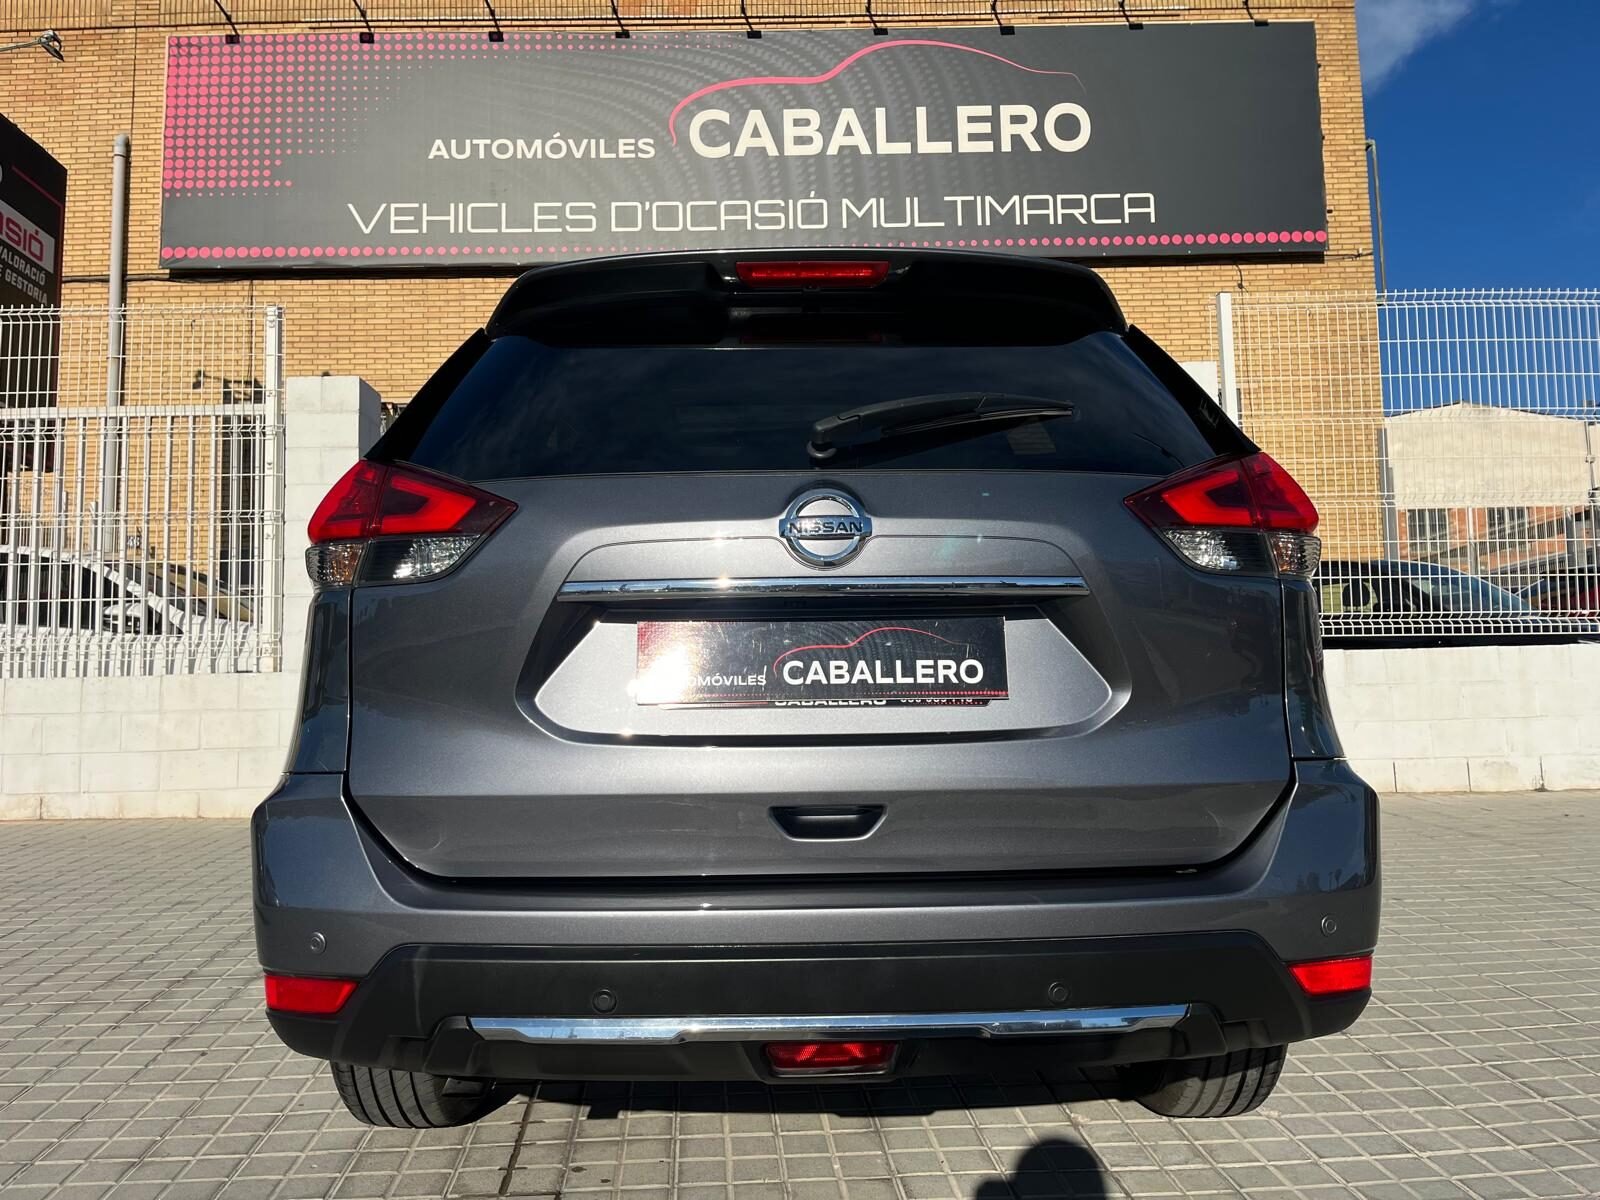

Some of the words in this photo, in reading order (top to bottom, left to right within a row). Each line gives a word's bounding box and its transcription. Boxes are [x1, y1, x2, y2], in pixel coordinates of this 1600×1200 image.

[427, 132, 656, 161] AUTOMÓVILES
[688, 102, 1092, 159] CABALLERO
[346, 201, 598, 235] VEHICLES
[610, 190, 828, 232] D'OCASIÓ
[841, 192, 1157, 229] MULTIMARCA
[0, 211, 45, 263] SIÓ
[4, 268, 48, 306] GESTORIA
[788, 521, 863, 533] NISSAN
[782, 659, 985, 686] CABALLERO
